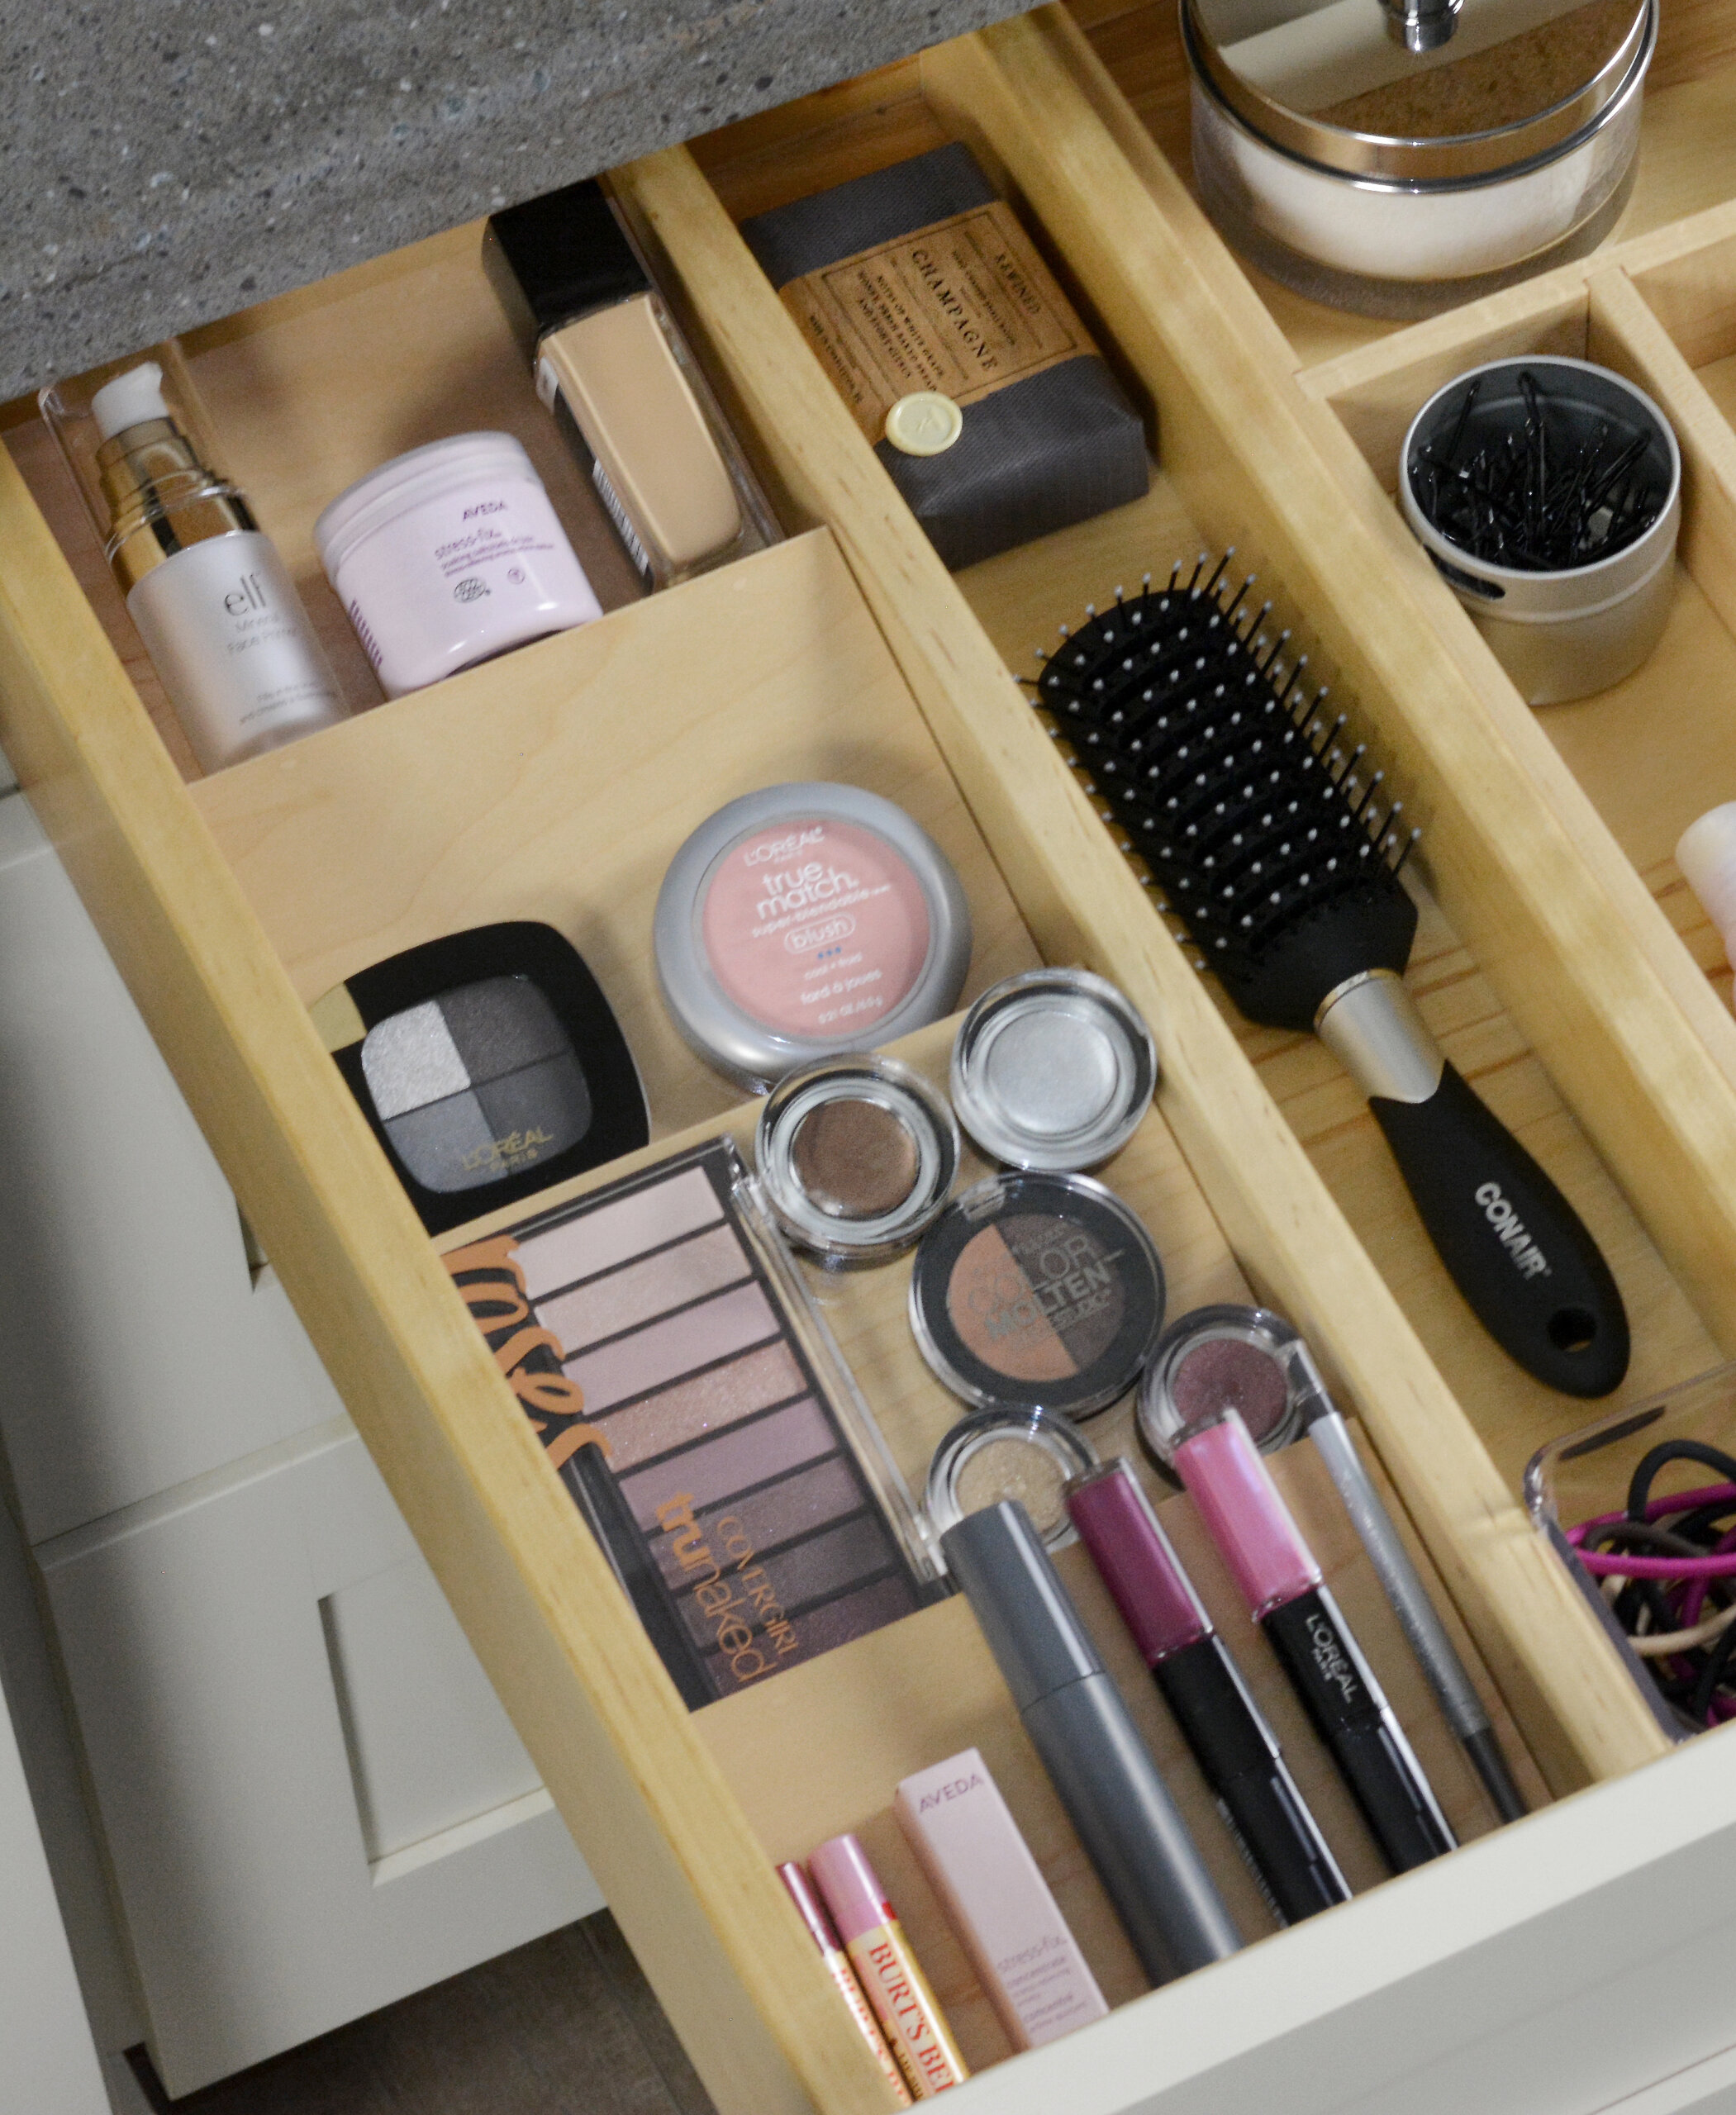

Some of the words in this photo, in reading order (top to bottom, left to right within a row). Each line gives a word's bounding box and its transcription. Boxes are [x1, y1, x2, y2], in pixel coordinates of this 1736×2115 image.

[910, 246, 1000, 373] CHAMPAGNE
[460, 497, 508, 521] AVEDA
[759, 860, 823, 895] true
[790, 917, 849, 949] blush
[1471, 1177, 1548, 1281] CONAIR
[966, 1233, 1098, 1314] COLOR
[983, 1258, 1113, 1342] MOLTEN
[713, 1513, 800, 1656] COVERGIRL
[914, 1770, 986, 1814] AVEDA
[866, 1940, 932, 2043] BURT'S
